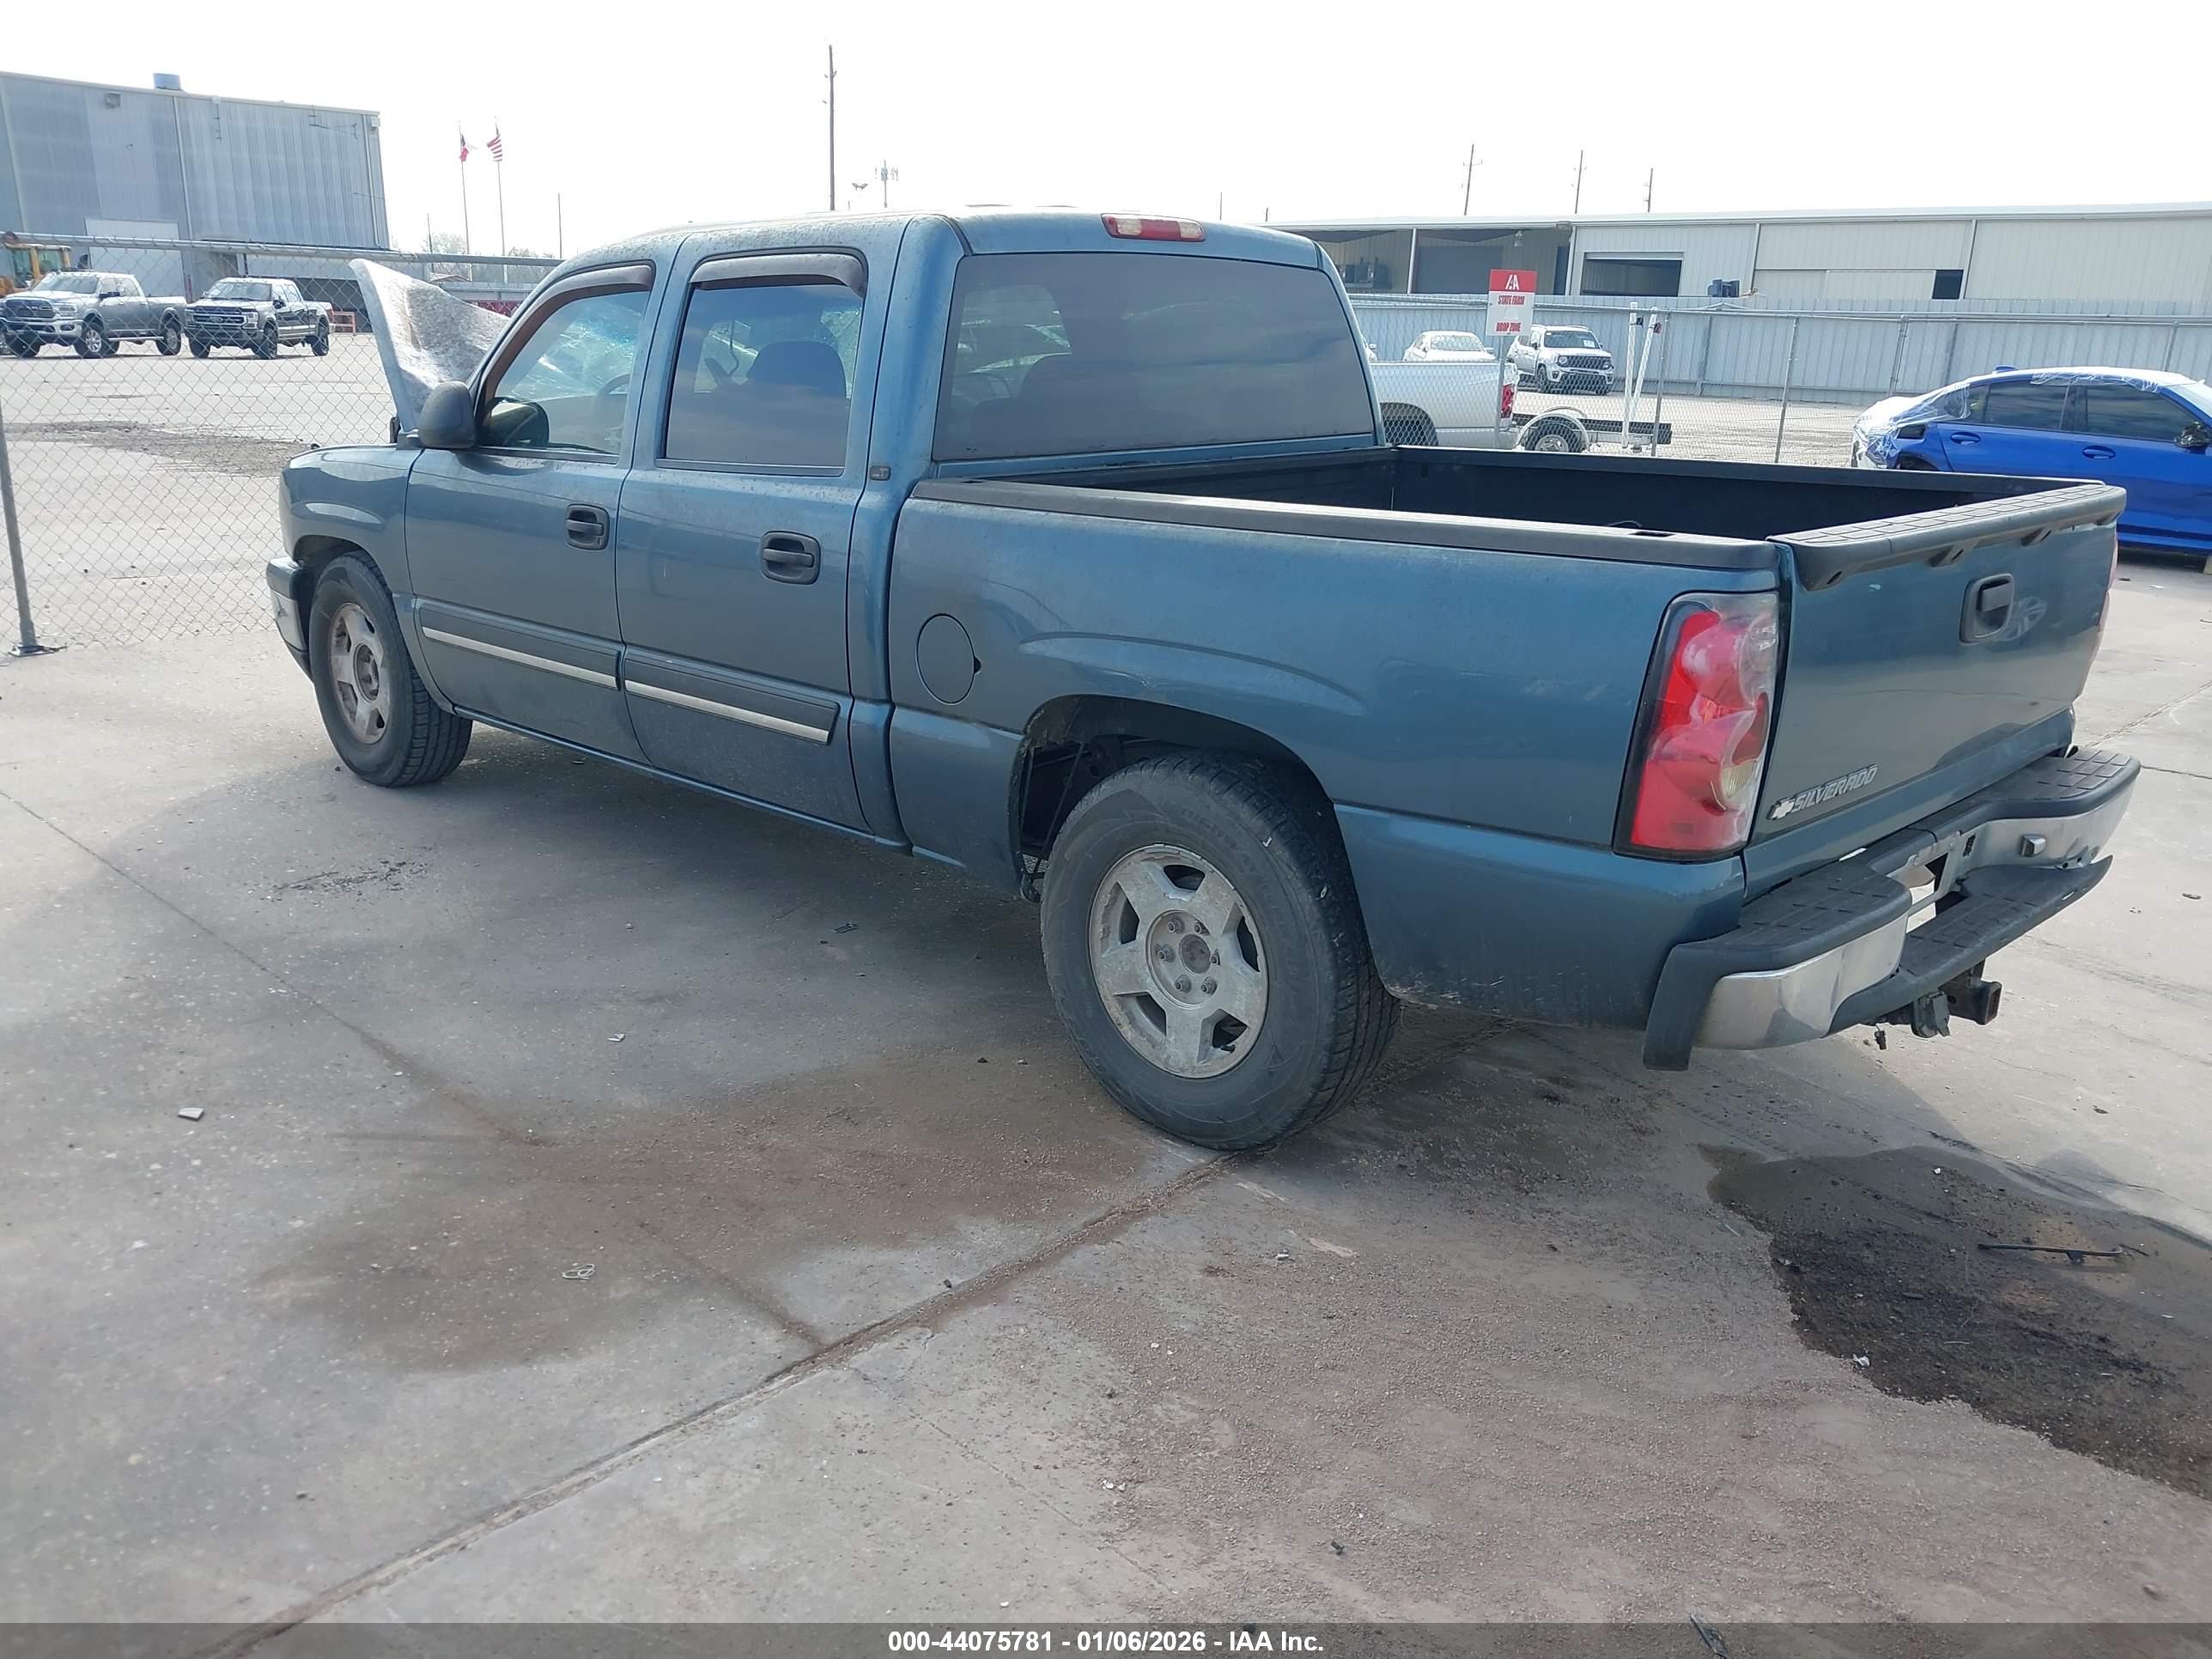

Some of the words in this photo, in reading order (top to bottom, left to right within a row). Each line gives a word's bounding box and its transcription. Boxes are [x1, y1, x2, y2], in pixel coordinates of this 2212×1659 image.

[1498, 295, 1511, 305] STATE
[1511, 295, 1525, 306] FARM
[1496, 322, 1509, 331] DROP
[1509, 322, 1522, 331] ZONE
[1791, 765, 1879, 812] SILVERADO
